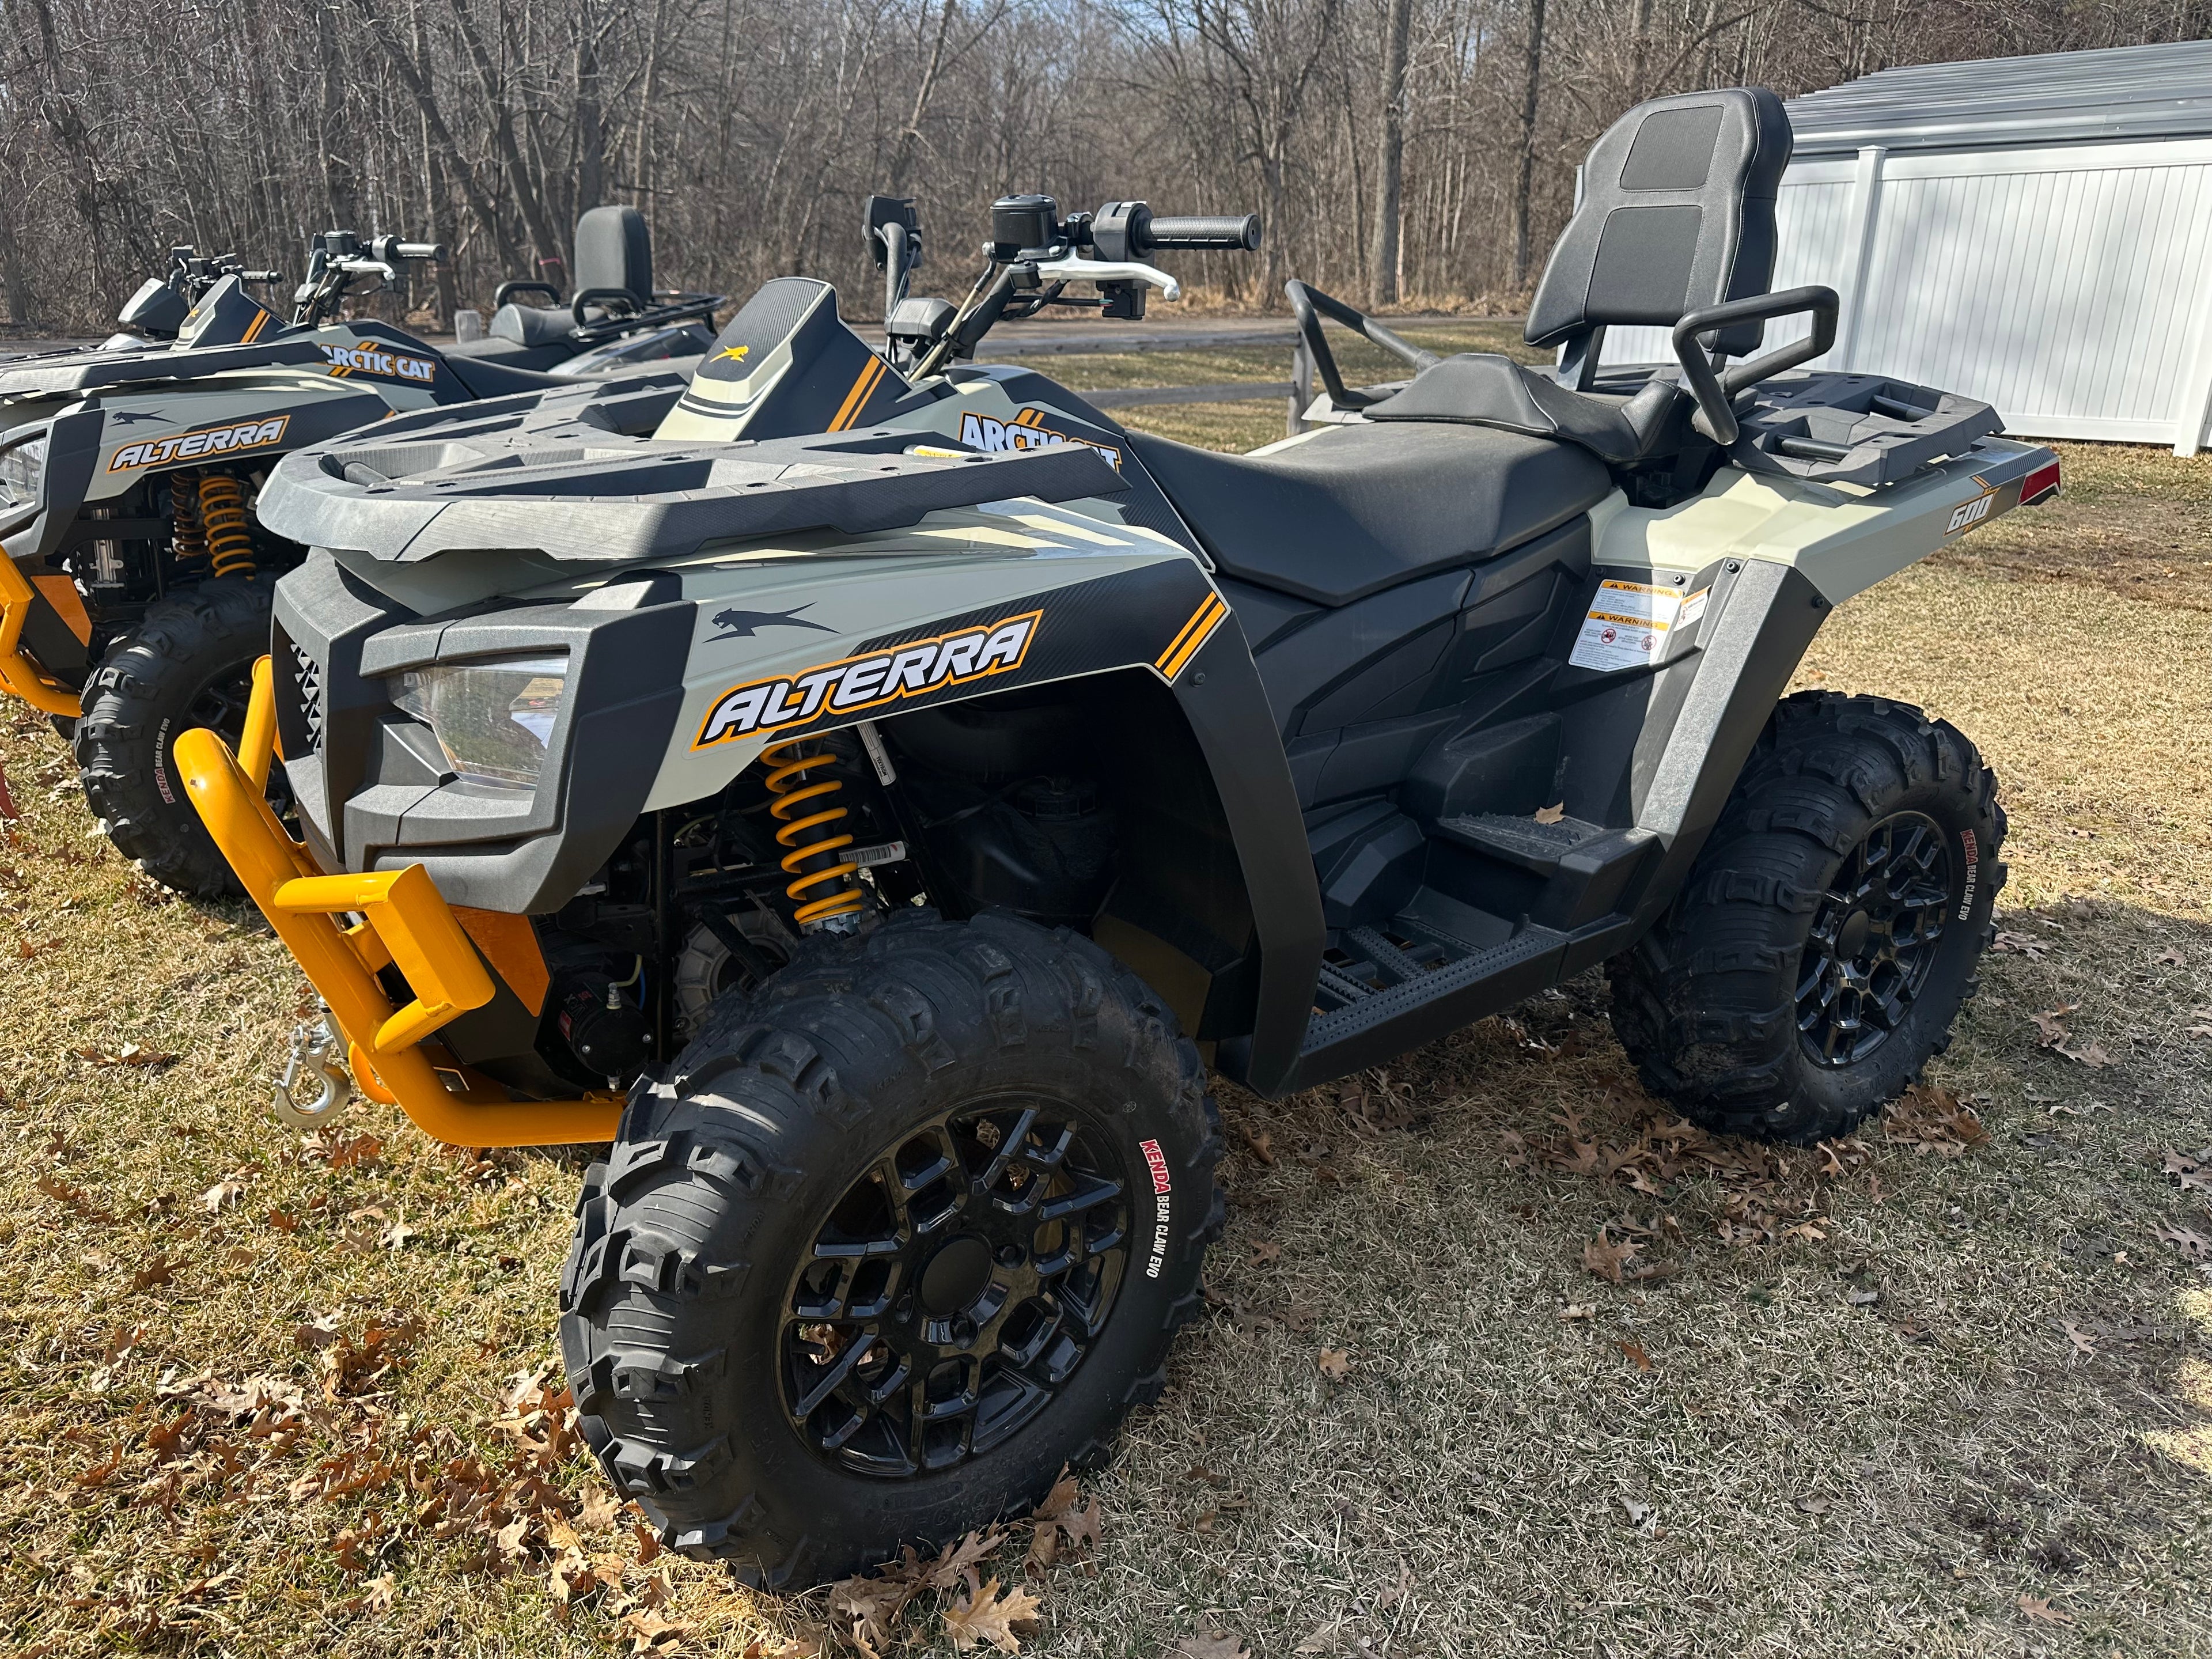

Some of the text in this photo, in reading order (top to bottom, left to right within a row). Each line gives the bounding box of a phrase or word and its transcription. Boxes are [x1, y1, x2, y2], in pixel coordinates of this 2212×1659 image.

[396, 358, 433, 380] CAT
[109, 418, 286, 471] ALTERRA
[961, 414, 1063, 452] ARCT
[1945, 493, 1994, 533] 600
[1623, 584, 1672, 596] WARNING
[1608, 615, 1658, 628] WARNING
[702, 619, 1033, 741] ALTERRA
[156, 731, 165, 749] CLAW
[161, 718, 170, 732] EVO
[154, 767, 176, 804] KENDA
[1958, 829, 1978, 921] KENDA BEAR CLAW EVO
[1139, 1139, 1171, 1278] KENDA BEAR CLAW EVO
